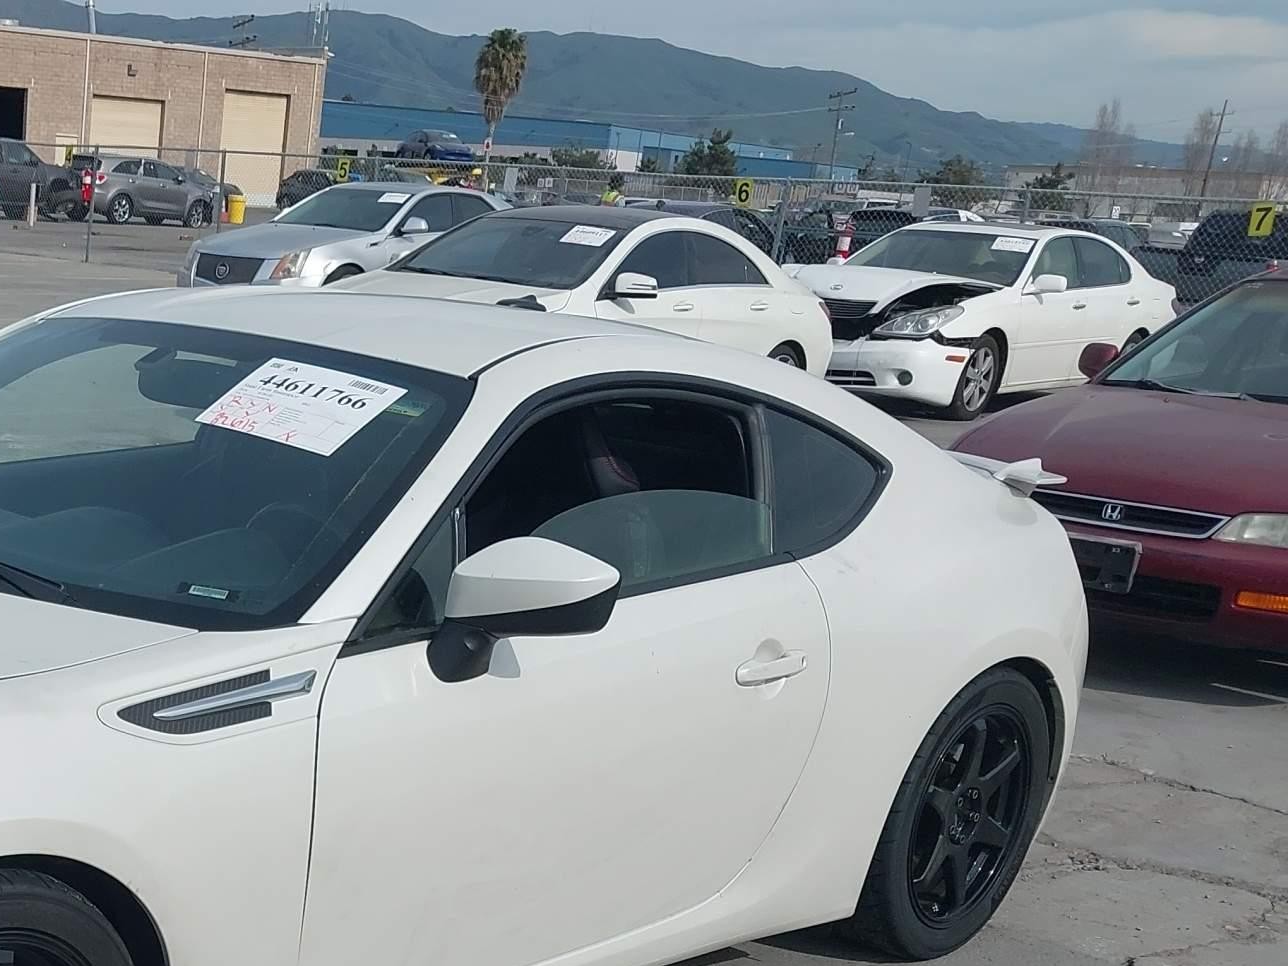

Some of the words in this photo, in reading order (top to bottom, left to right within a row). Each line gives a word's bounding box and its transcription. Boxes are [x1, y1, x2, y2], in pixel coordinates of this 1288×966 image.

[339, 161, 348, 178] 5
[738, 182, 750, 203] 6
[1255, 206, 1273, 232] 7
[258, 374, 374, 410] 44611766
